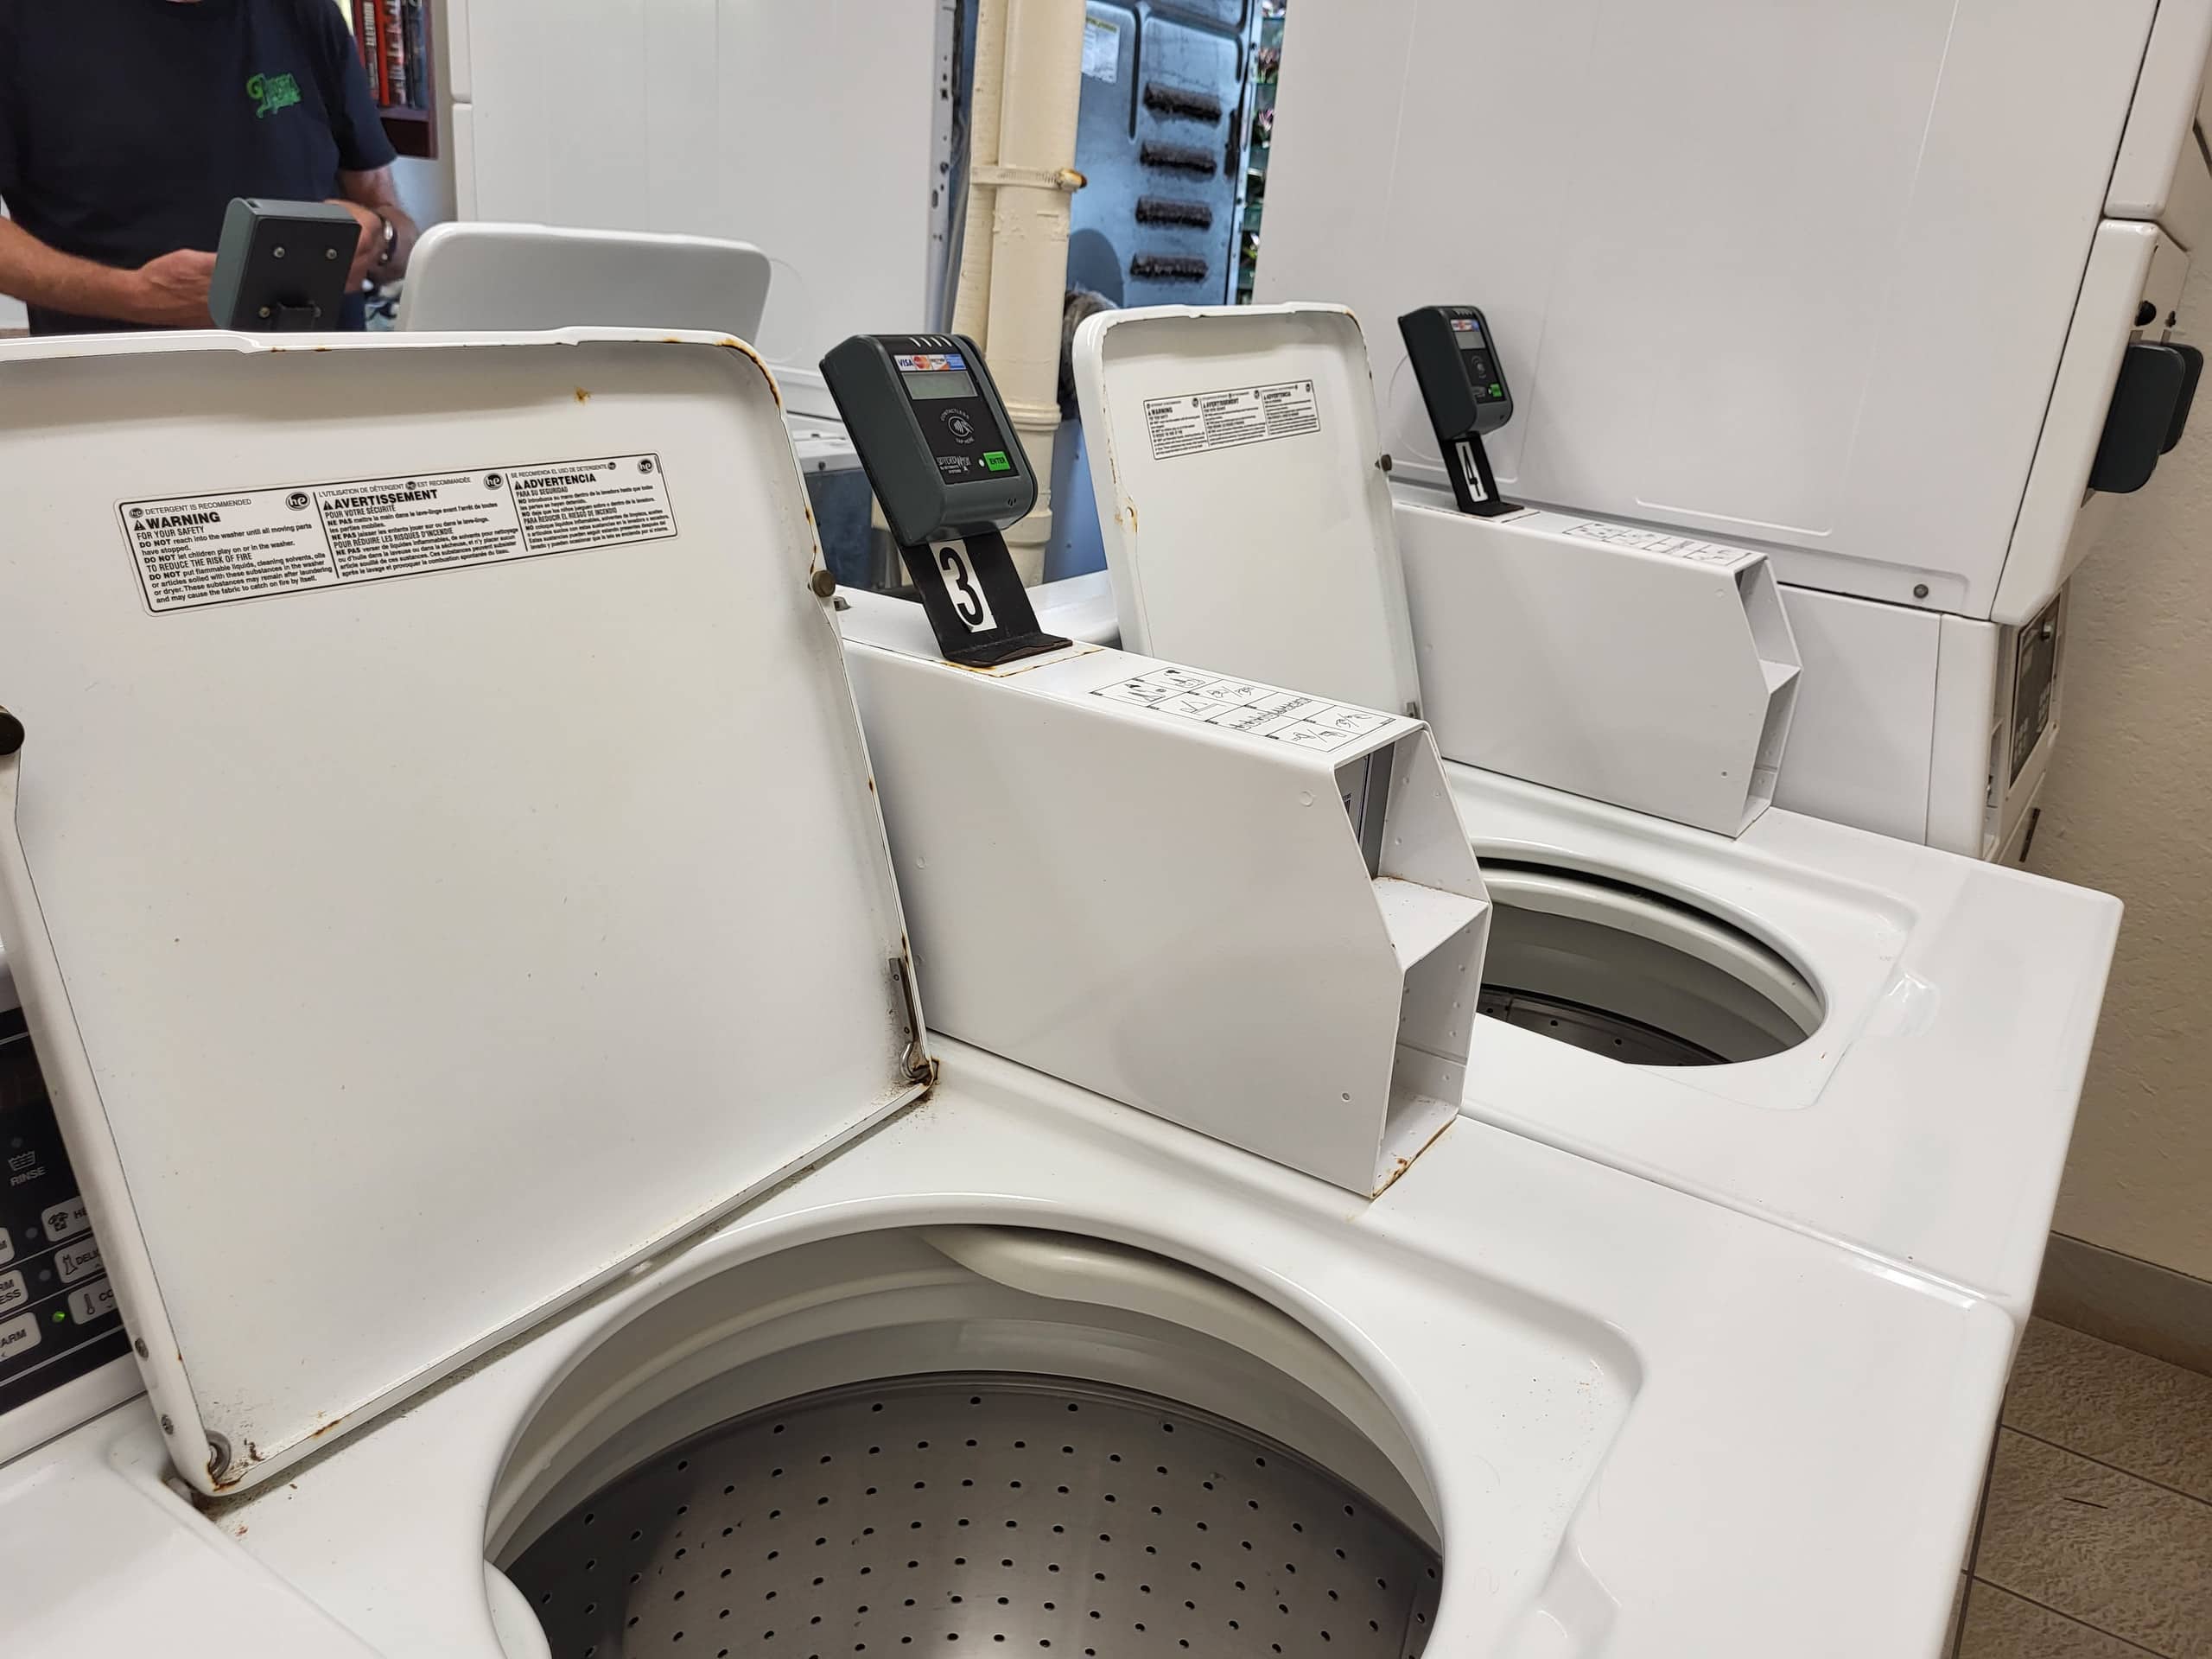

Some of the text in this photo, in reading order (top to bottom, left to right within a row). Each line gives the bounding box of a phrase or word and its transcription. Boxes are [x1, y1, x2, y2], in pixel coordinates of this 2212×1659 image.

[899, 359, 914, 367] VISA
[988, 456, 1007, 465] ENTER
[1462, 445, 1481, 498] 4
[523, 472, 595, 489] ADVERTENCIA
[144, 505, 189, 514] DETERGENT
[198, 499, 251, 508] RECOMMENDED
[334, 490, 438, 508] AVERTISSEMENT
[344, 507, 365, 516] VOTRE
[365, 504, 396, 513] SÉCURITÉ
[145, 512, 221, 528] WARNING
[154, 529, 175, 537] YOUR
[176, 526, 205, 535] SAFETY
[352, 536, 379, 545] RÉDUIRE
[393, 531, 420, 540] RISQUES
[421, 528, 453, 537] D'INCENDIE
[160, 544, 190, 554] stopped.
[270, 539, 295, 548] washer.
[158, 561, 188, 570] REDUCE
[195, 564, 231, 575] flammable
[232, 562, 256, 570] liquids,
[257, 557, 284, 567] cleaning
[284, 554, 313, 563] solvents,
[160, 578, 187, 587] articles
[245, 565, 282, 575] substances
[162, 587, 184, 595] dryer.
[184, 583, 205, 592] These
[206, 577, 245, 588] substances
[260, 572, 283, 581] remain
[299, 565, 332, 576] laundering
[939, 546, 984, 627] 3
[10, 1166, 46, 1186] RINSE
[75, 1248, 99, 1266] DELI
[0, 1329, 28, 1347] ARM
